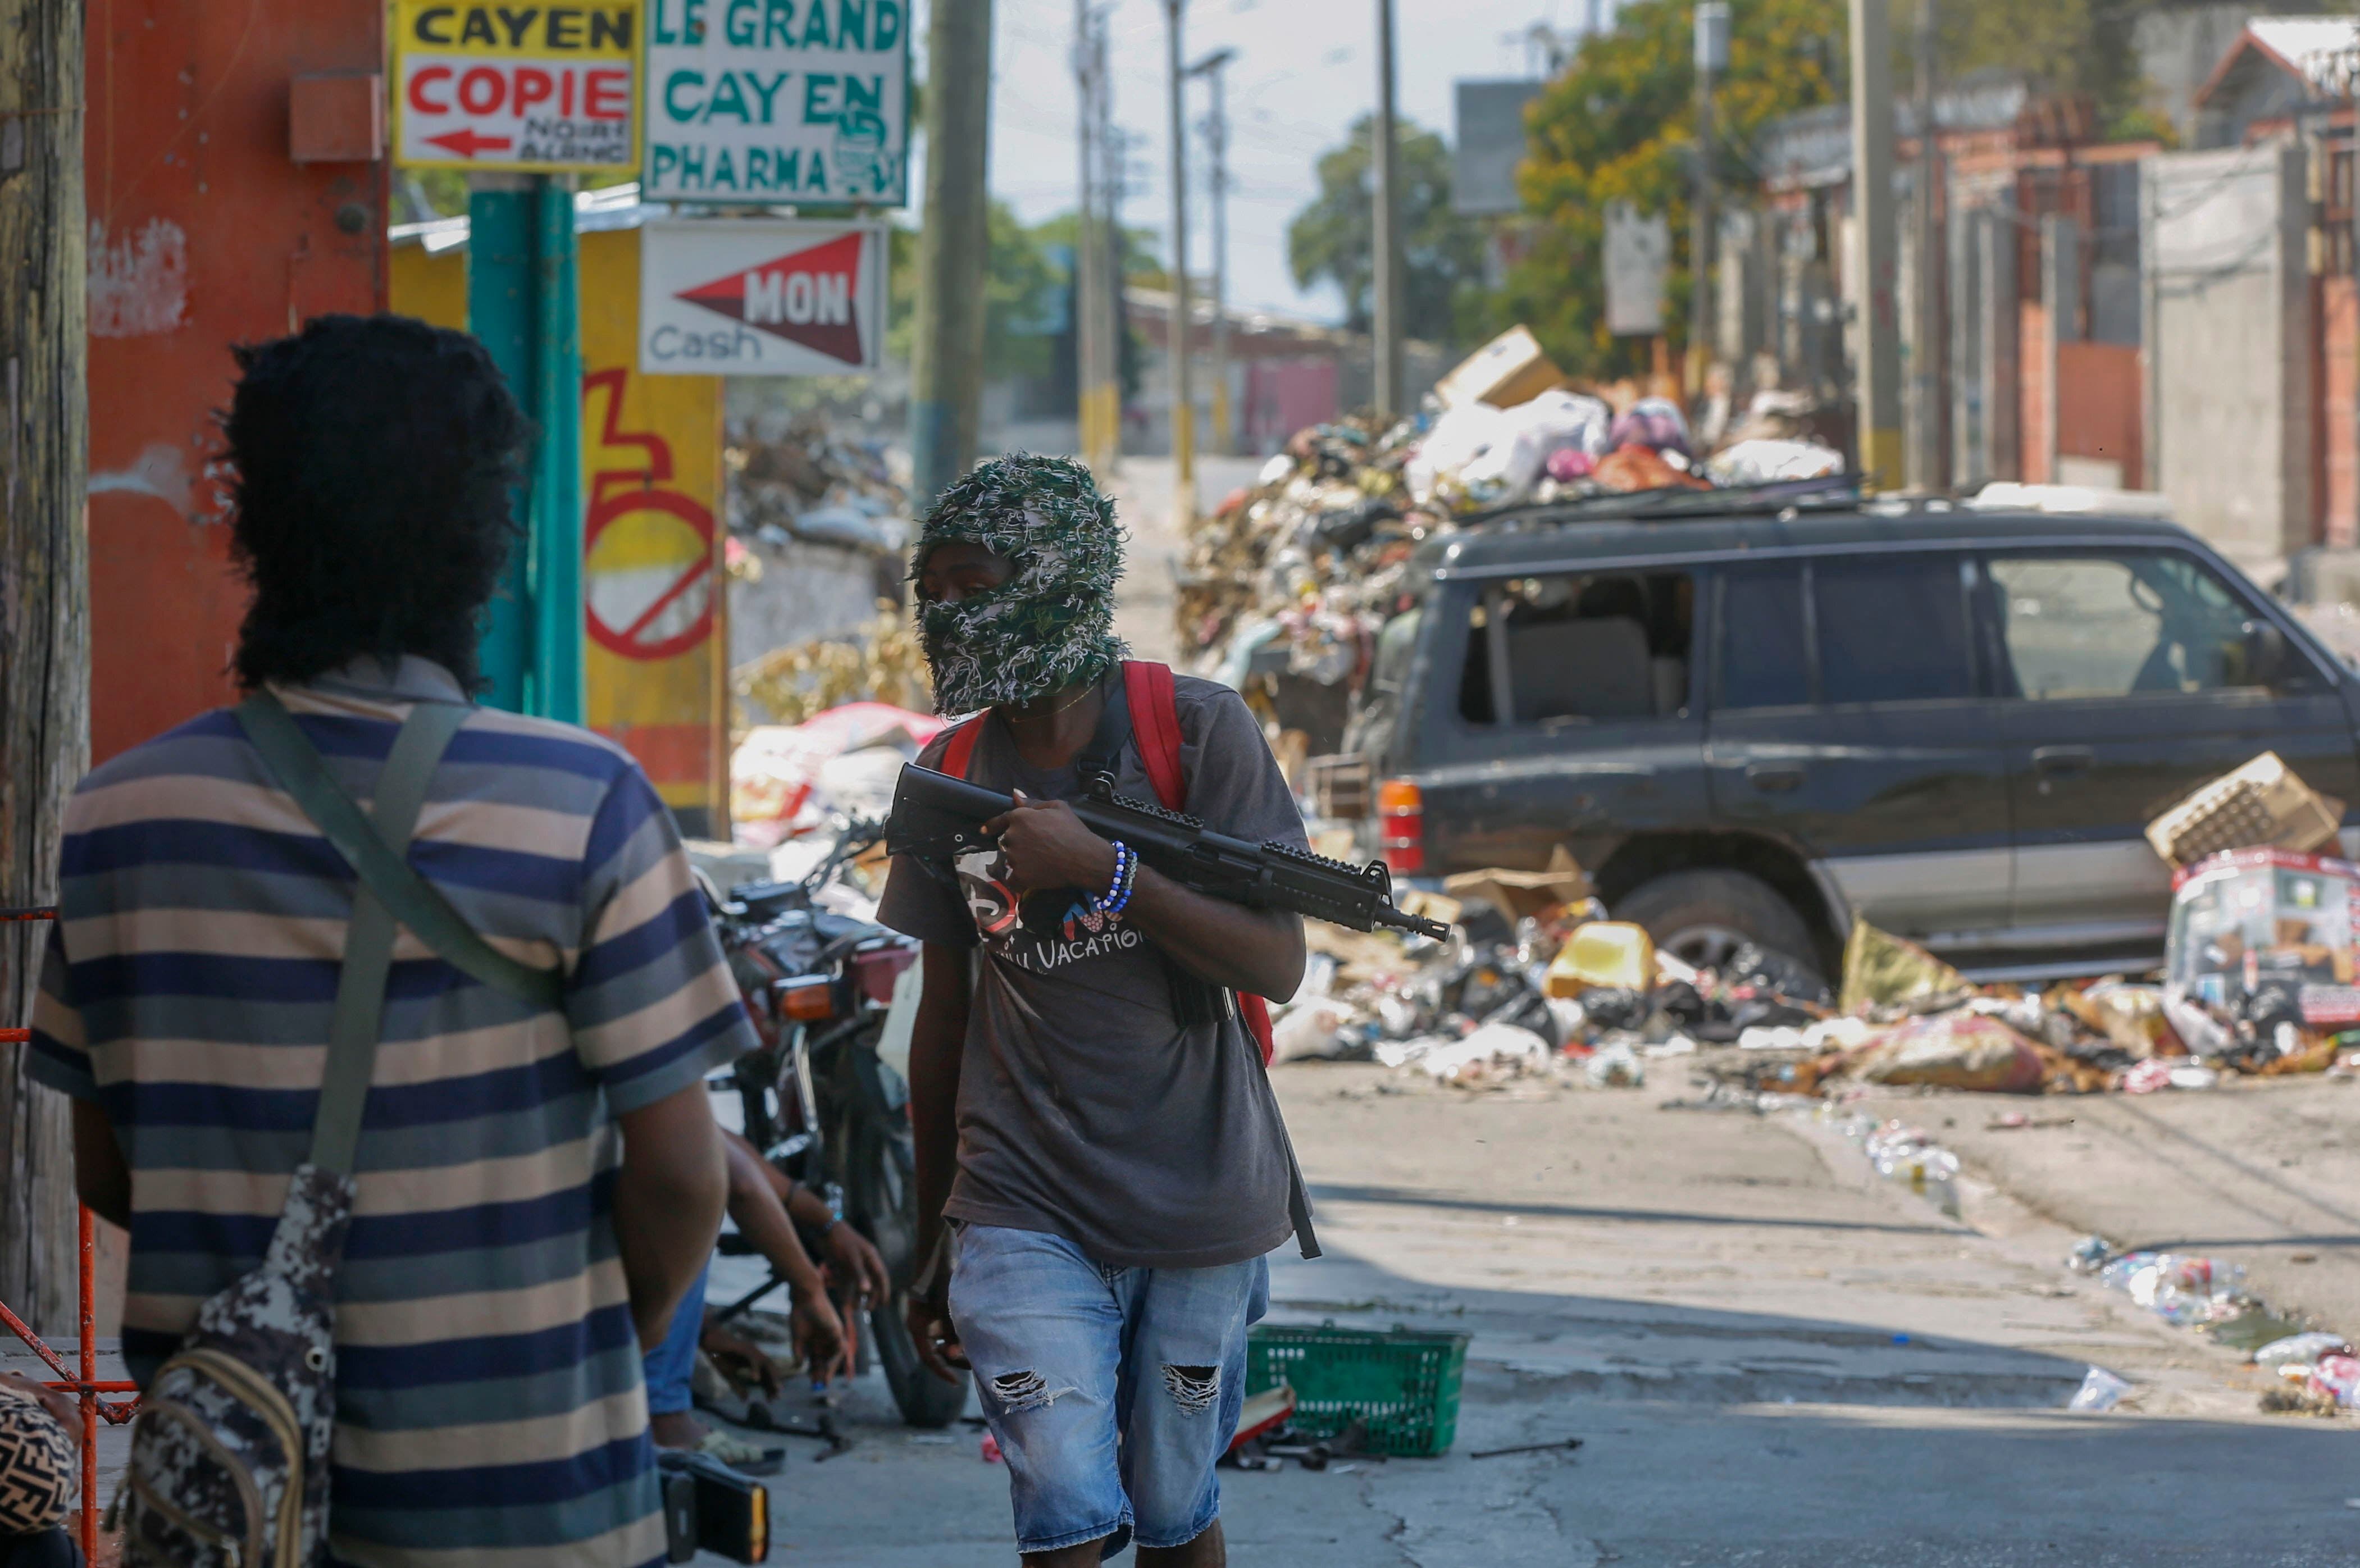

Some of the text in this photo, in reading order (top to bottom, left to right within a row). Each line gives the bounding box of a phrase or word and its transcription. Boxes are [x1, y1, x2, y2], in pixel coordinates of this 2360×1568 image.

[416, 7, 631, 49] CAYEN
[654, 0, 900, 50] LE GRAND
[409, 66, 627, 118] COPIE
[664, 70, 885, 125] CAYEN
[744, 270, 850, 326] MON
[649, 323, 763, 361] Cash
